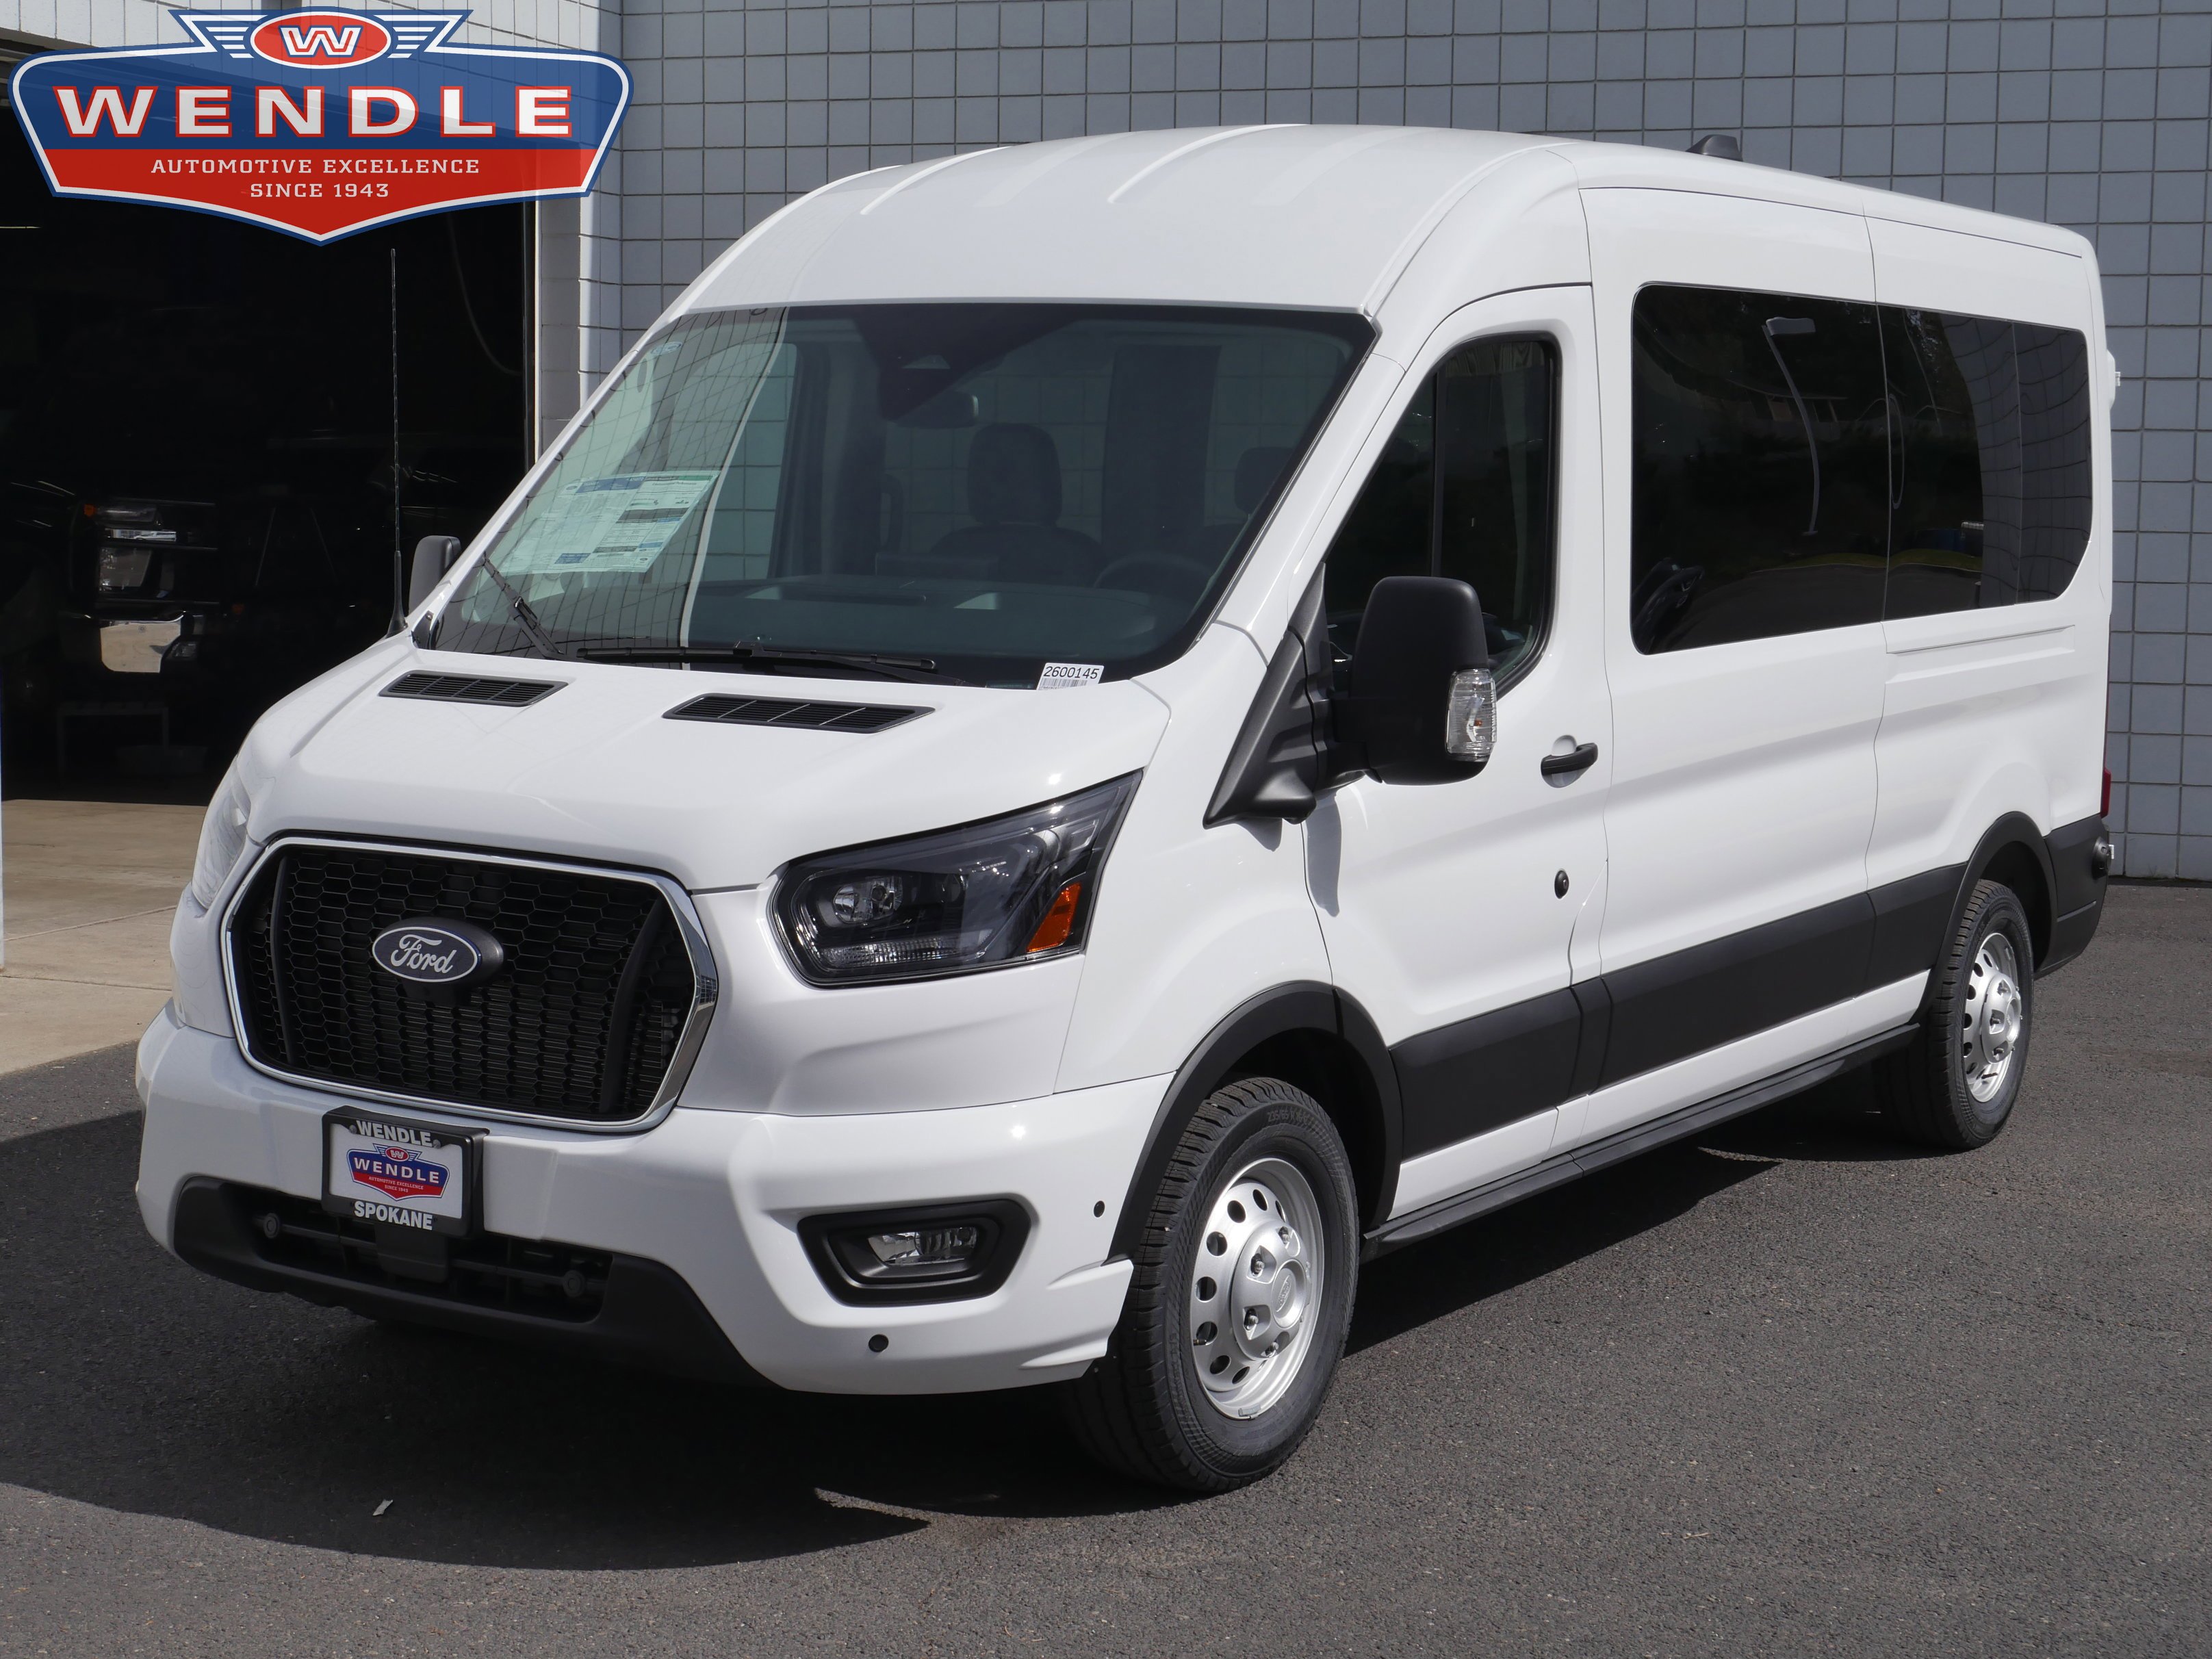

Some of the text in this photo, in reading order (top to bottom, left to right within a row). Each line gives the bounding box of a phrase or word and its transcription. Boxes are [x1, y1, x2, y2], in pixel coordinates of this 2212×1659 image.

[1043, 666, 1100, 679] 2600145
[391, 934, 457, 973] Ford
[355, 1120, 433, 1147] WENDLE
[354, 1157, 439, 1184] WENDLE
[368, 1176, 424, 1190] AUTOMOTIVE EXCELLENCE
[354, 1200, 433, 1231] SPOKANE
